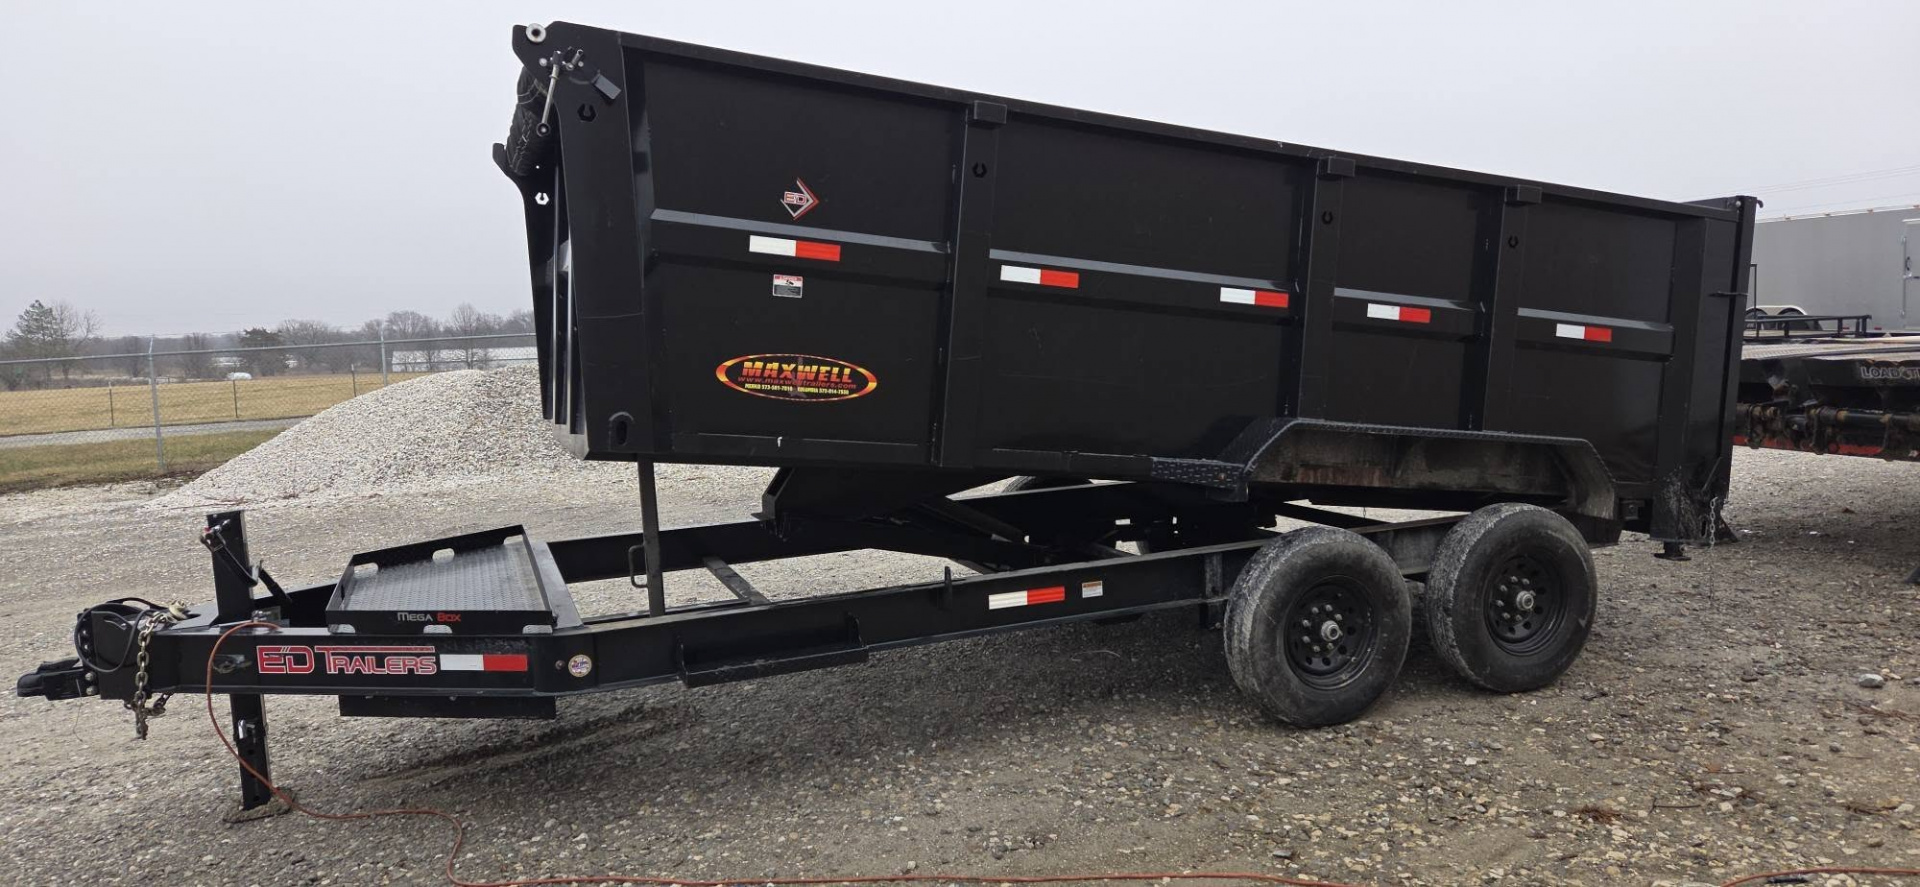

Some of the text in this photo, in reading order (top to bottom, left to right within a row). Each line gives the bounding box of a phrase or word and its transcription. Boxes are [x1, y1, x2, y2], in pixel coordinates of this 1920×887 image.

[784, 191, 807, 206] ED
[742, 361, 853, 383] MAXWELL
[1860, 366, 1900, 379] LOAD
[397, 612, 434, 622] MEGA
[256, 645, 438, 675] ED TRAILERS
